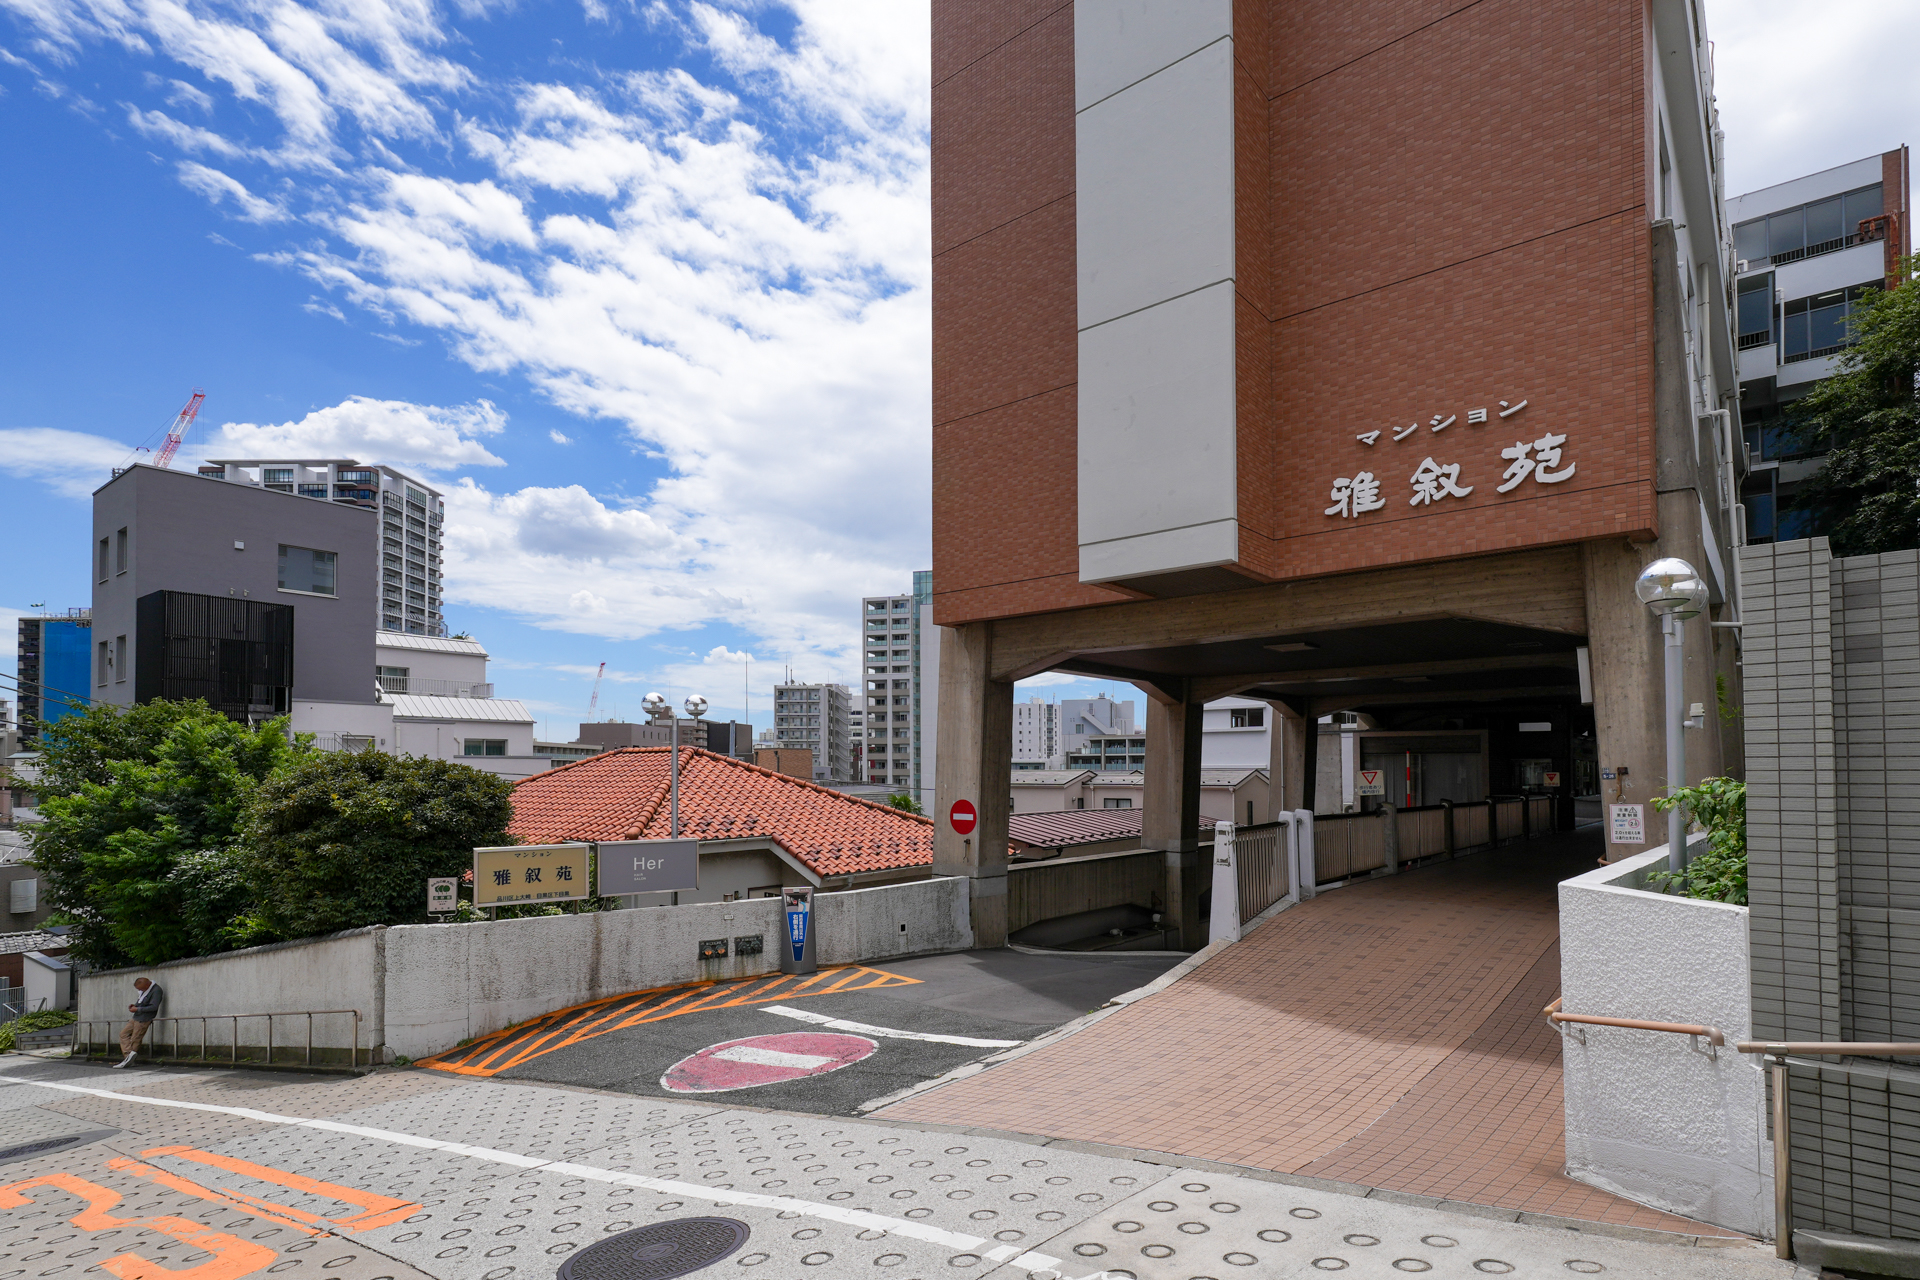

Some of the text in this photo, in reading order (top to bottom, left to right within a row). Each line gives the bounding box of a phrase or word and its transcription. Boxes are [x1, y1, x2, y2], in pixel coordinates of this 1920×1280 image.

[1356, 399, 1528, 446] マンション
[1324, 432, 1576, 518] 雅叙苑
[493, 865, 573, 886] 雅叙苑
[633, 857, 664, 871] Her
